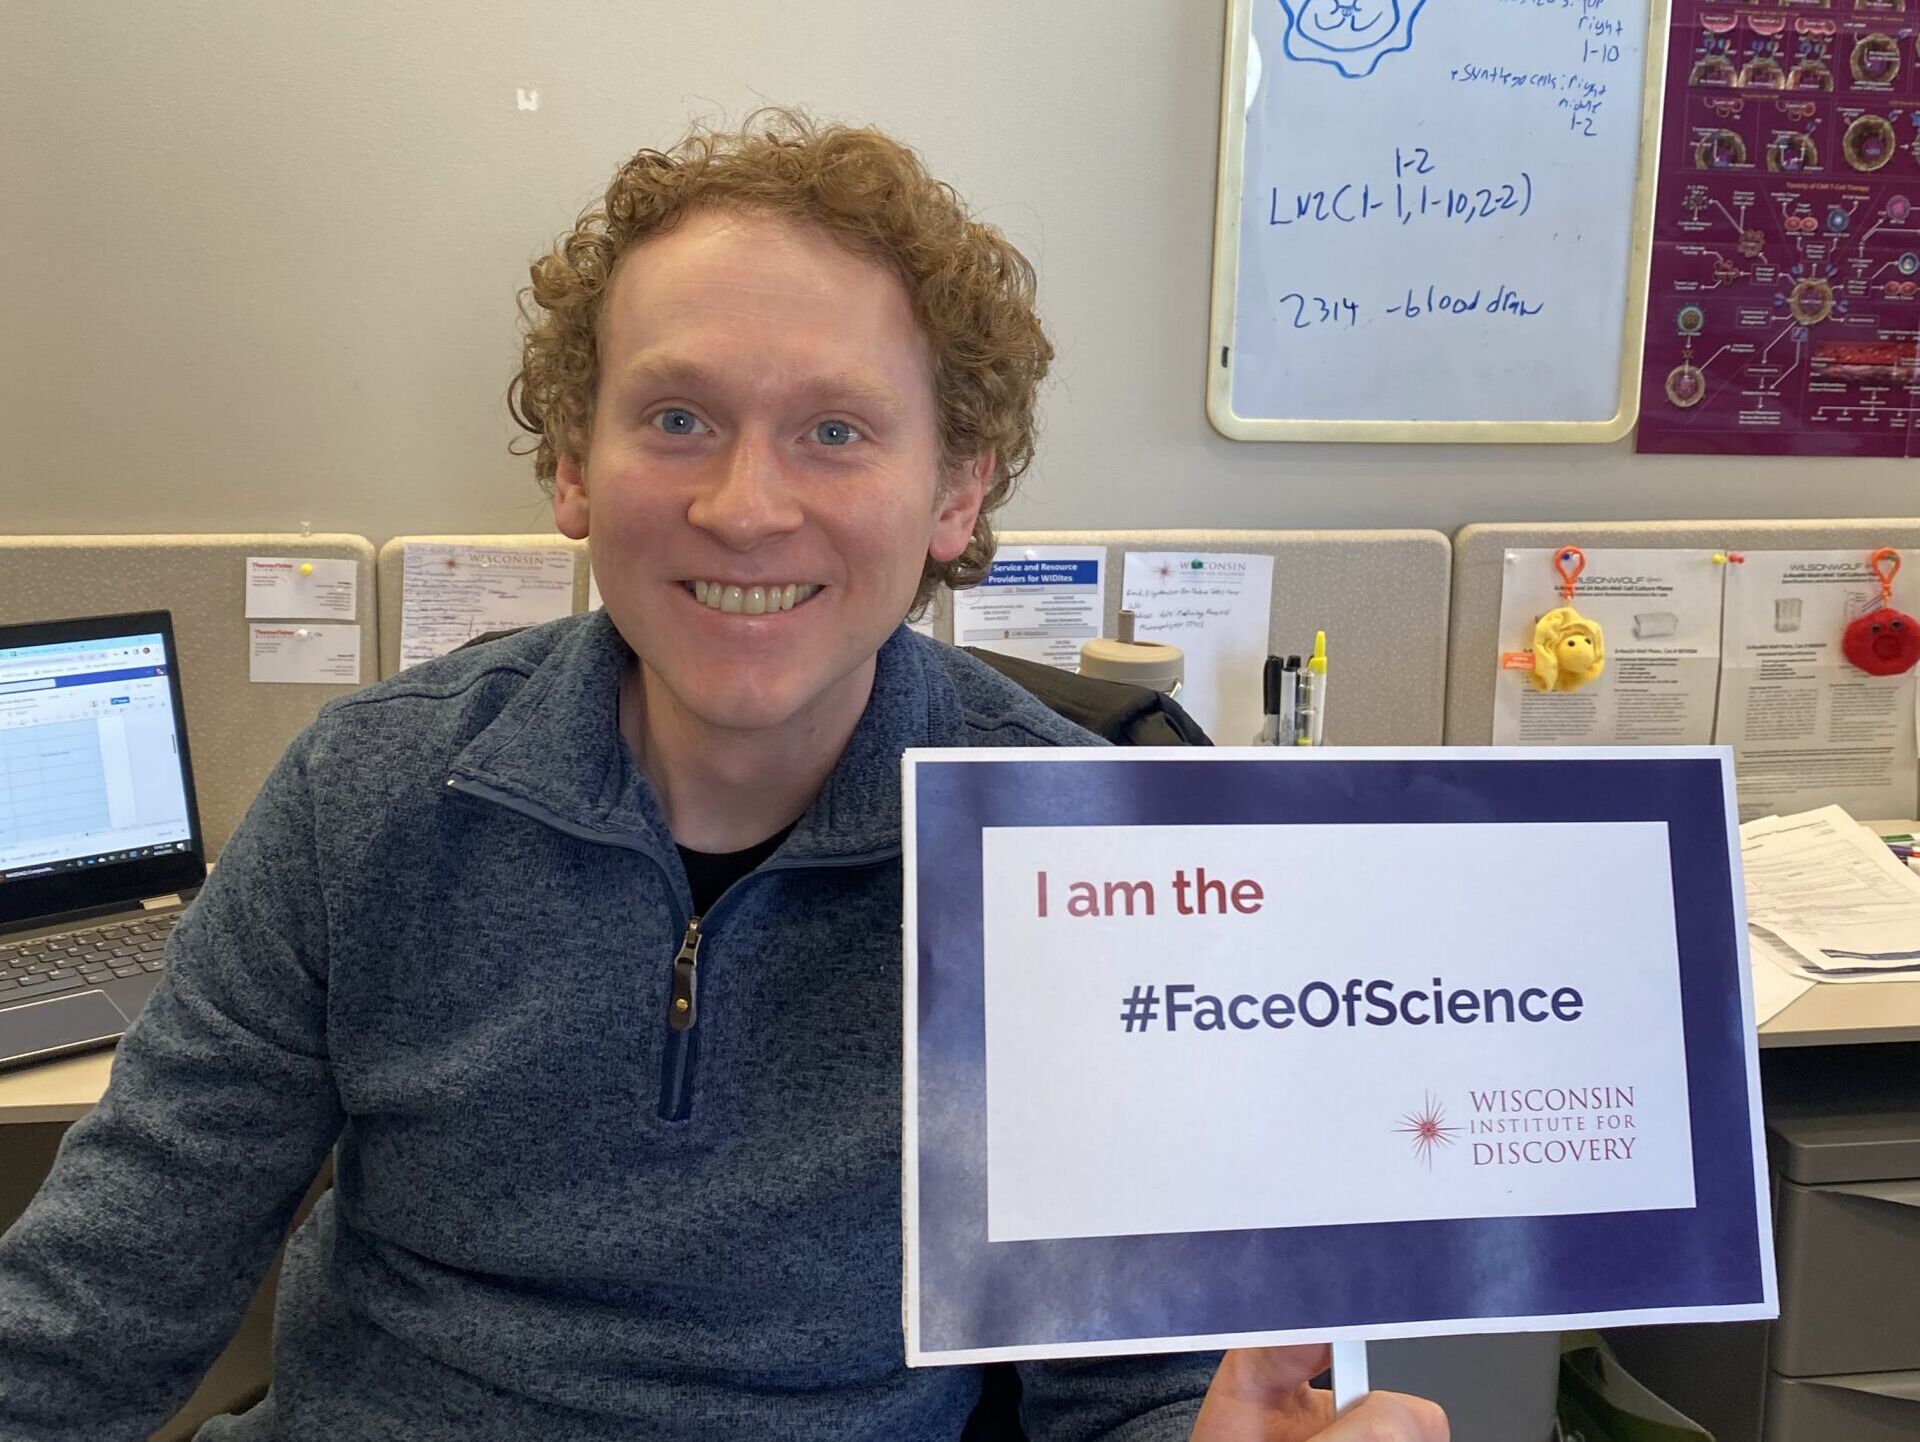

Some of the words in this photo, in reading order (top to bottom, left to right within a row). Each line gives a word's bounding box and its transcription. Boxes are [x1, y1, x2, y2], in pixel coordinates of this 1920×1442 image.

[1578, 15, 1624, 36] right
[1583, 39, 1620, 62] 1-10
[1571, 111, 1598, 136] 1-2
[1395, 147, 1435, 178] 1-2
[1280, 293, 1359, 328] 2314
[993, 563, 1022, 572] Service
[1024, 563, 1039, 572] and
[1041, 563, 1077, 572] Resource
[1179, 560, 1247, 571] WCONSIN
[988, 575, 1025, 584] Providers
[1027, 575, 1038, 583] for
[1037, 871, 1048, 917] I
[1067, 879, 1155, 918] am
[1172, 867, 1264, 916] the
[1119, 977, 1584, 1033] #FaceOfScience
[1468, 1086, 1635, 1113] WISCONSIN
[1470, 1116, 1585, 1134] INSTITUTE
[1597, 1114, 1637, 1130] FOR
[1472, 1137, 1636, 1165] DISCOVERY
